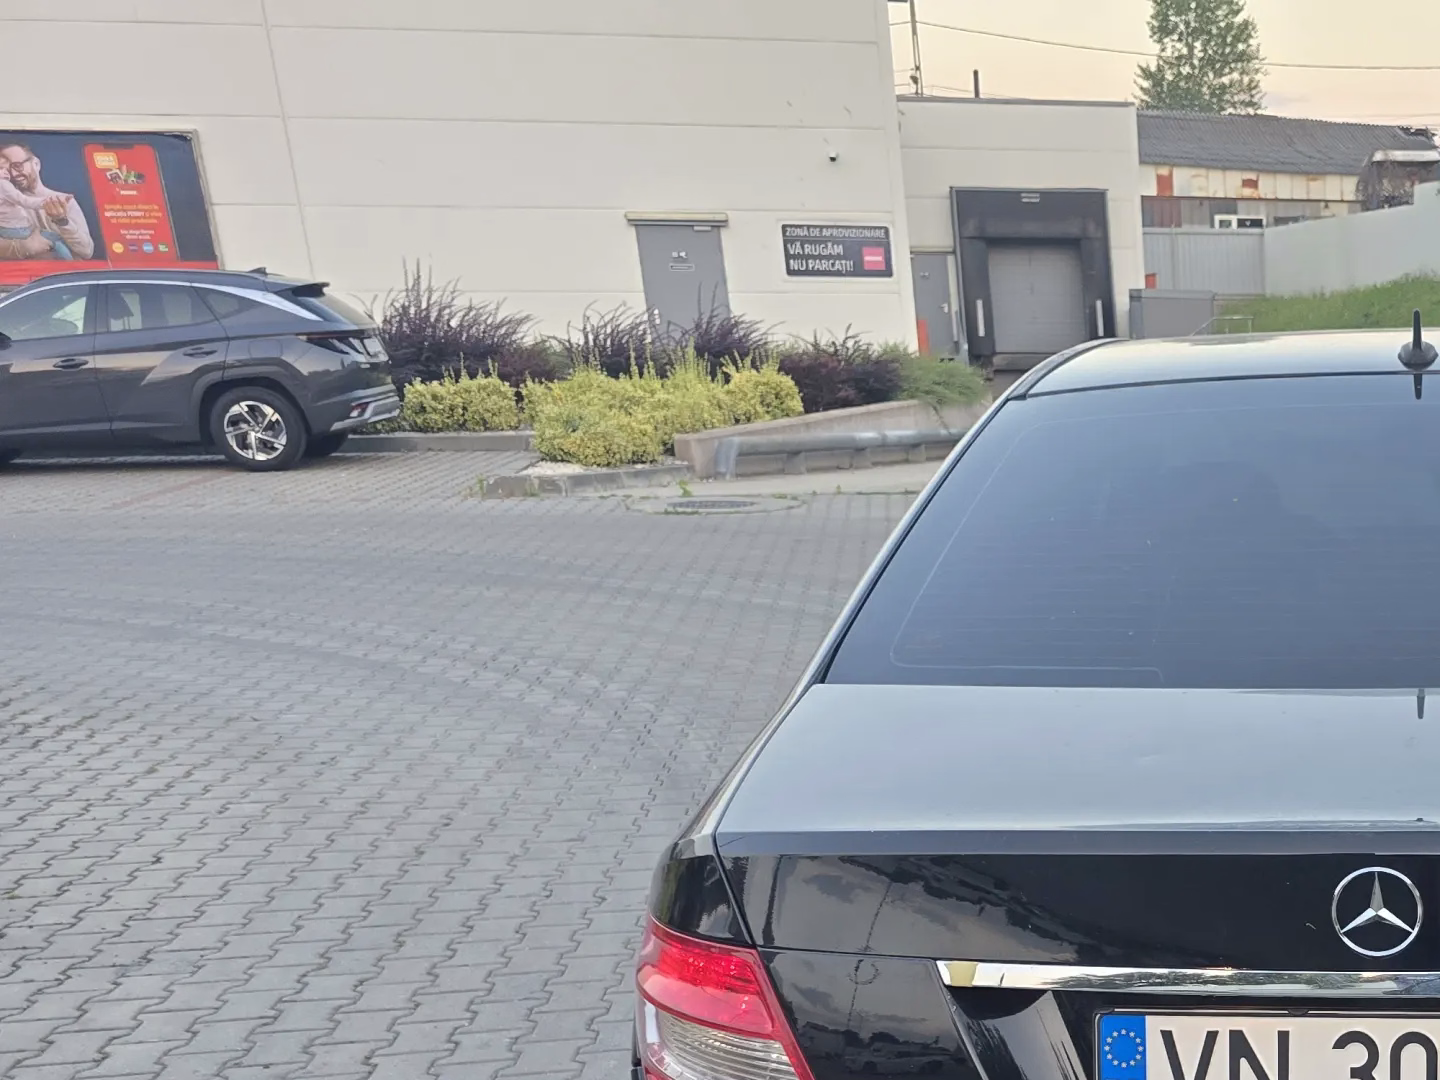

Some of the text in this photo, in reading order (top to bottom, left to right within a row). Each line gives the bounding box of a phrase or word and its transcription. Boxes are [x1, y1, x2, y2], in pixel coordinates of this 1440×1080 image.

[785, 226, 886, 238] ZONĂ DE APROVIZIONARE
[787, 241, 844, 256] VĂ RUGĂM
[790, 259, 807, 271] NU
